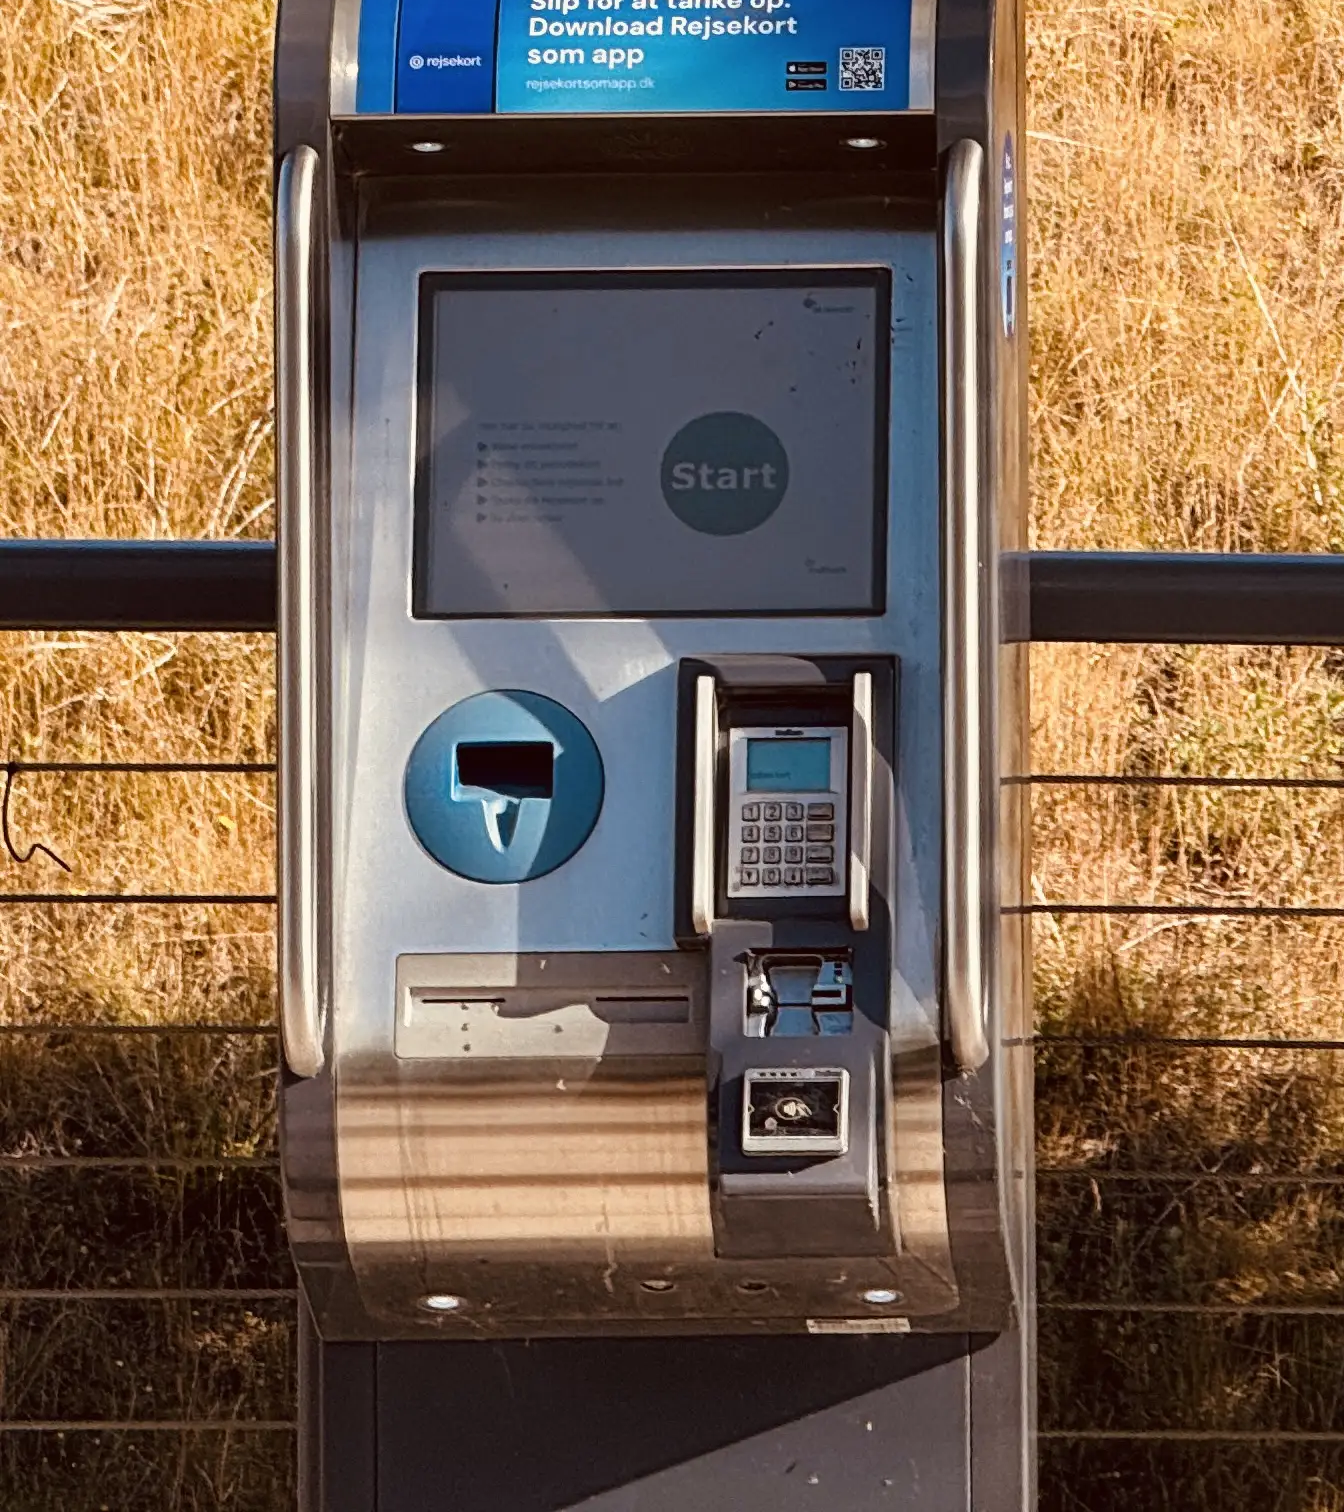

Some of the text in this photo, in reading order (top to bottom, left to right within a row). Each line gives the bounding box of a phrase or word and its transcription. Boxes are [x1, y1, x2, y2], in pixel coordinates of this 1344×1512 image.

[530, 16, 797, 40] Download Rejsekort
[427, 55, 481, 68] rejsekort
[528, 49, 644, 69] som app
[526, 77, 653, 92] rejsekortsomapp.dk
[672, 463, 775, 490] Start
